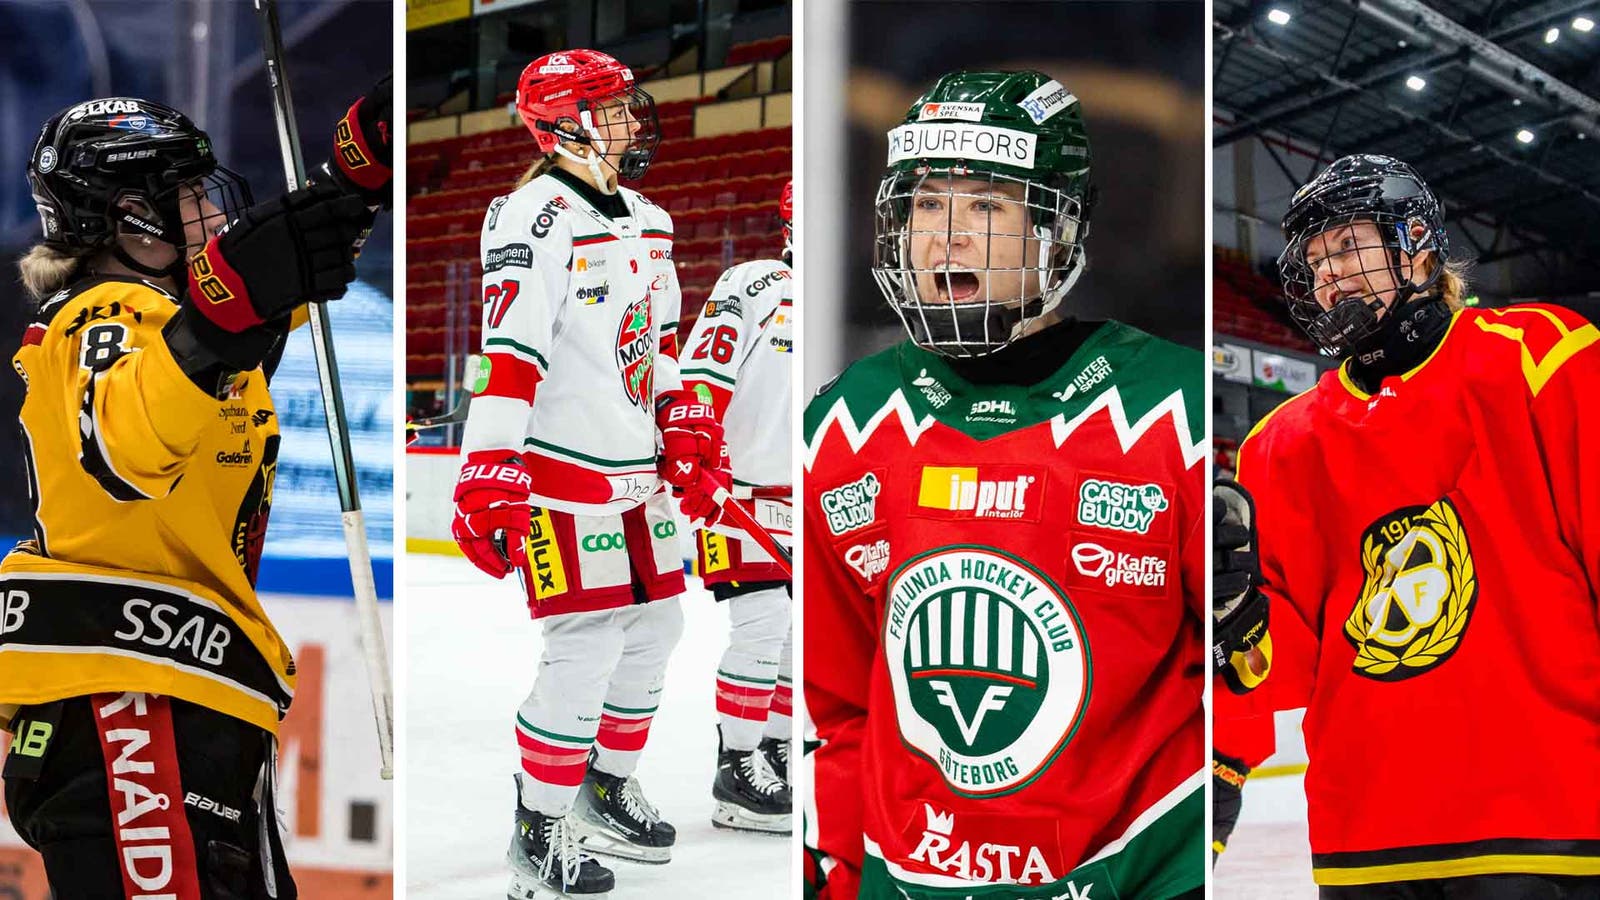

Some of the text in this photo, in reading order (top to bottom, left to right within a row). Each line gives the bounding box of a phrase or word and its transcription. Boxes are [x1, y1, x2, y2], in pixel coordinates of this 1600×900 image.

[88, 101, 140, 115] LKAB
[940, 104, 980, 113] SVENSKA
[106, 149, 157, 163] BAUER
[903, 130, 1028, 160] BJURFORS
[123, 214, 164, 236] BAUER
[483, 279, 520, 329] 77
[692, 324, 738, 365] 26
[1073, 356, 1108, 386] INTER
[1080, 364, 1113, 393] SPORT
[920, 387, 945, 410] SPORT
[823, 484, 866, 513] CASH
[950, 474, 1028, 517] input
[1082, 482, 1138, 509] CASH
[1080, 502, 1153, 532] BUDDY
[582, 532, 627, 554] coo
[1105, 567, 1165, 587] greven
[1116, 552, 1167, 573] Kaffe
[890, 558, 1074, 653] FRÖLUNDA HOCKEY CLUB
[114, 598, 231, 666] SSAB
[939, 748, 1019, 786] GÖTEBORG
[184, 791, 242, 823] BAUER
[909, 831, 1057, 885] RASTA
